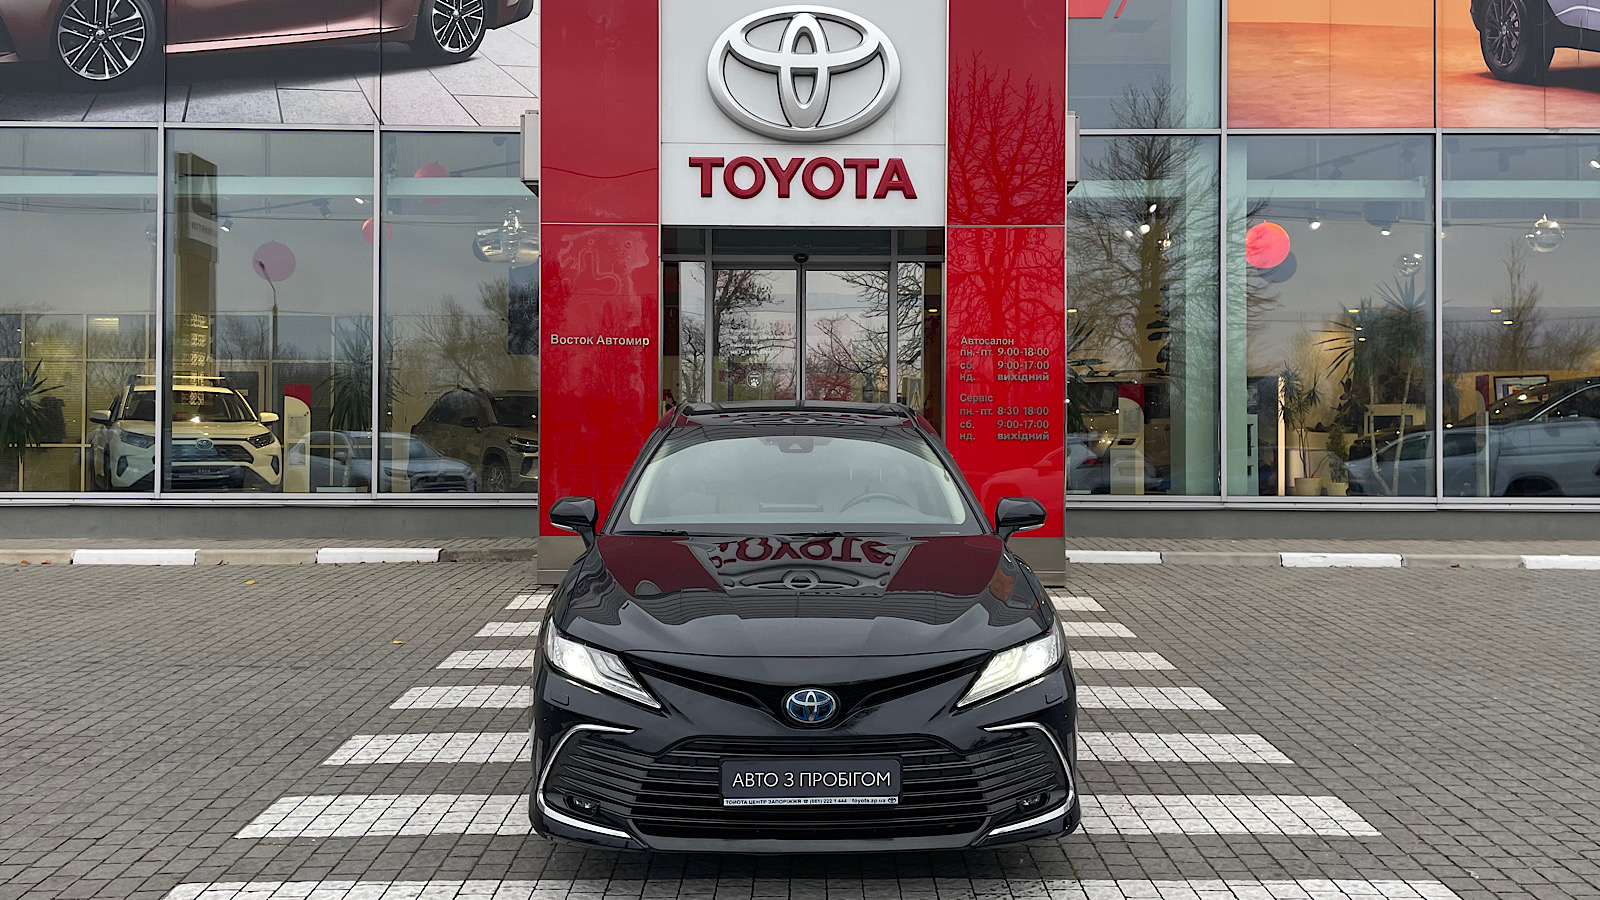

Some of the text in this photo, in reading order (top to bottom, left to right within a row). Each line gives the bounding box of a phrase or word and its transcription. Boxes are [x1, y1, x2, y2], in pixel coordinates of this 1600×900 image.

[688, 156, 918, 200] TOYOTA
[550, 334, 650, 348] Восток Автомир
[960, 336, 1015, 345] Автосалон
[960, 360, 1050, 370] сб. 9:00-17:00
[960, 372, 1050, 382] нд. вихідний
[960, 393, 994, 404] Сервіс
[960, 420, 1050, 429] сб. 9:00-17:00
[960, 431, 1050, 442] нд. вихідний
[732, 772, 779, 787] АВТО
[799, 771, 891, 787] ПРОБІГОМ
